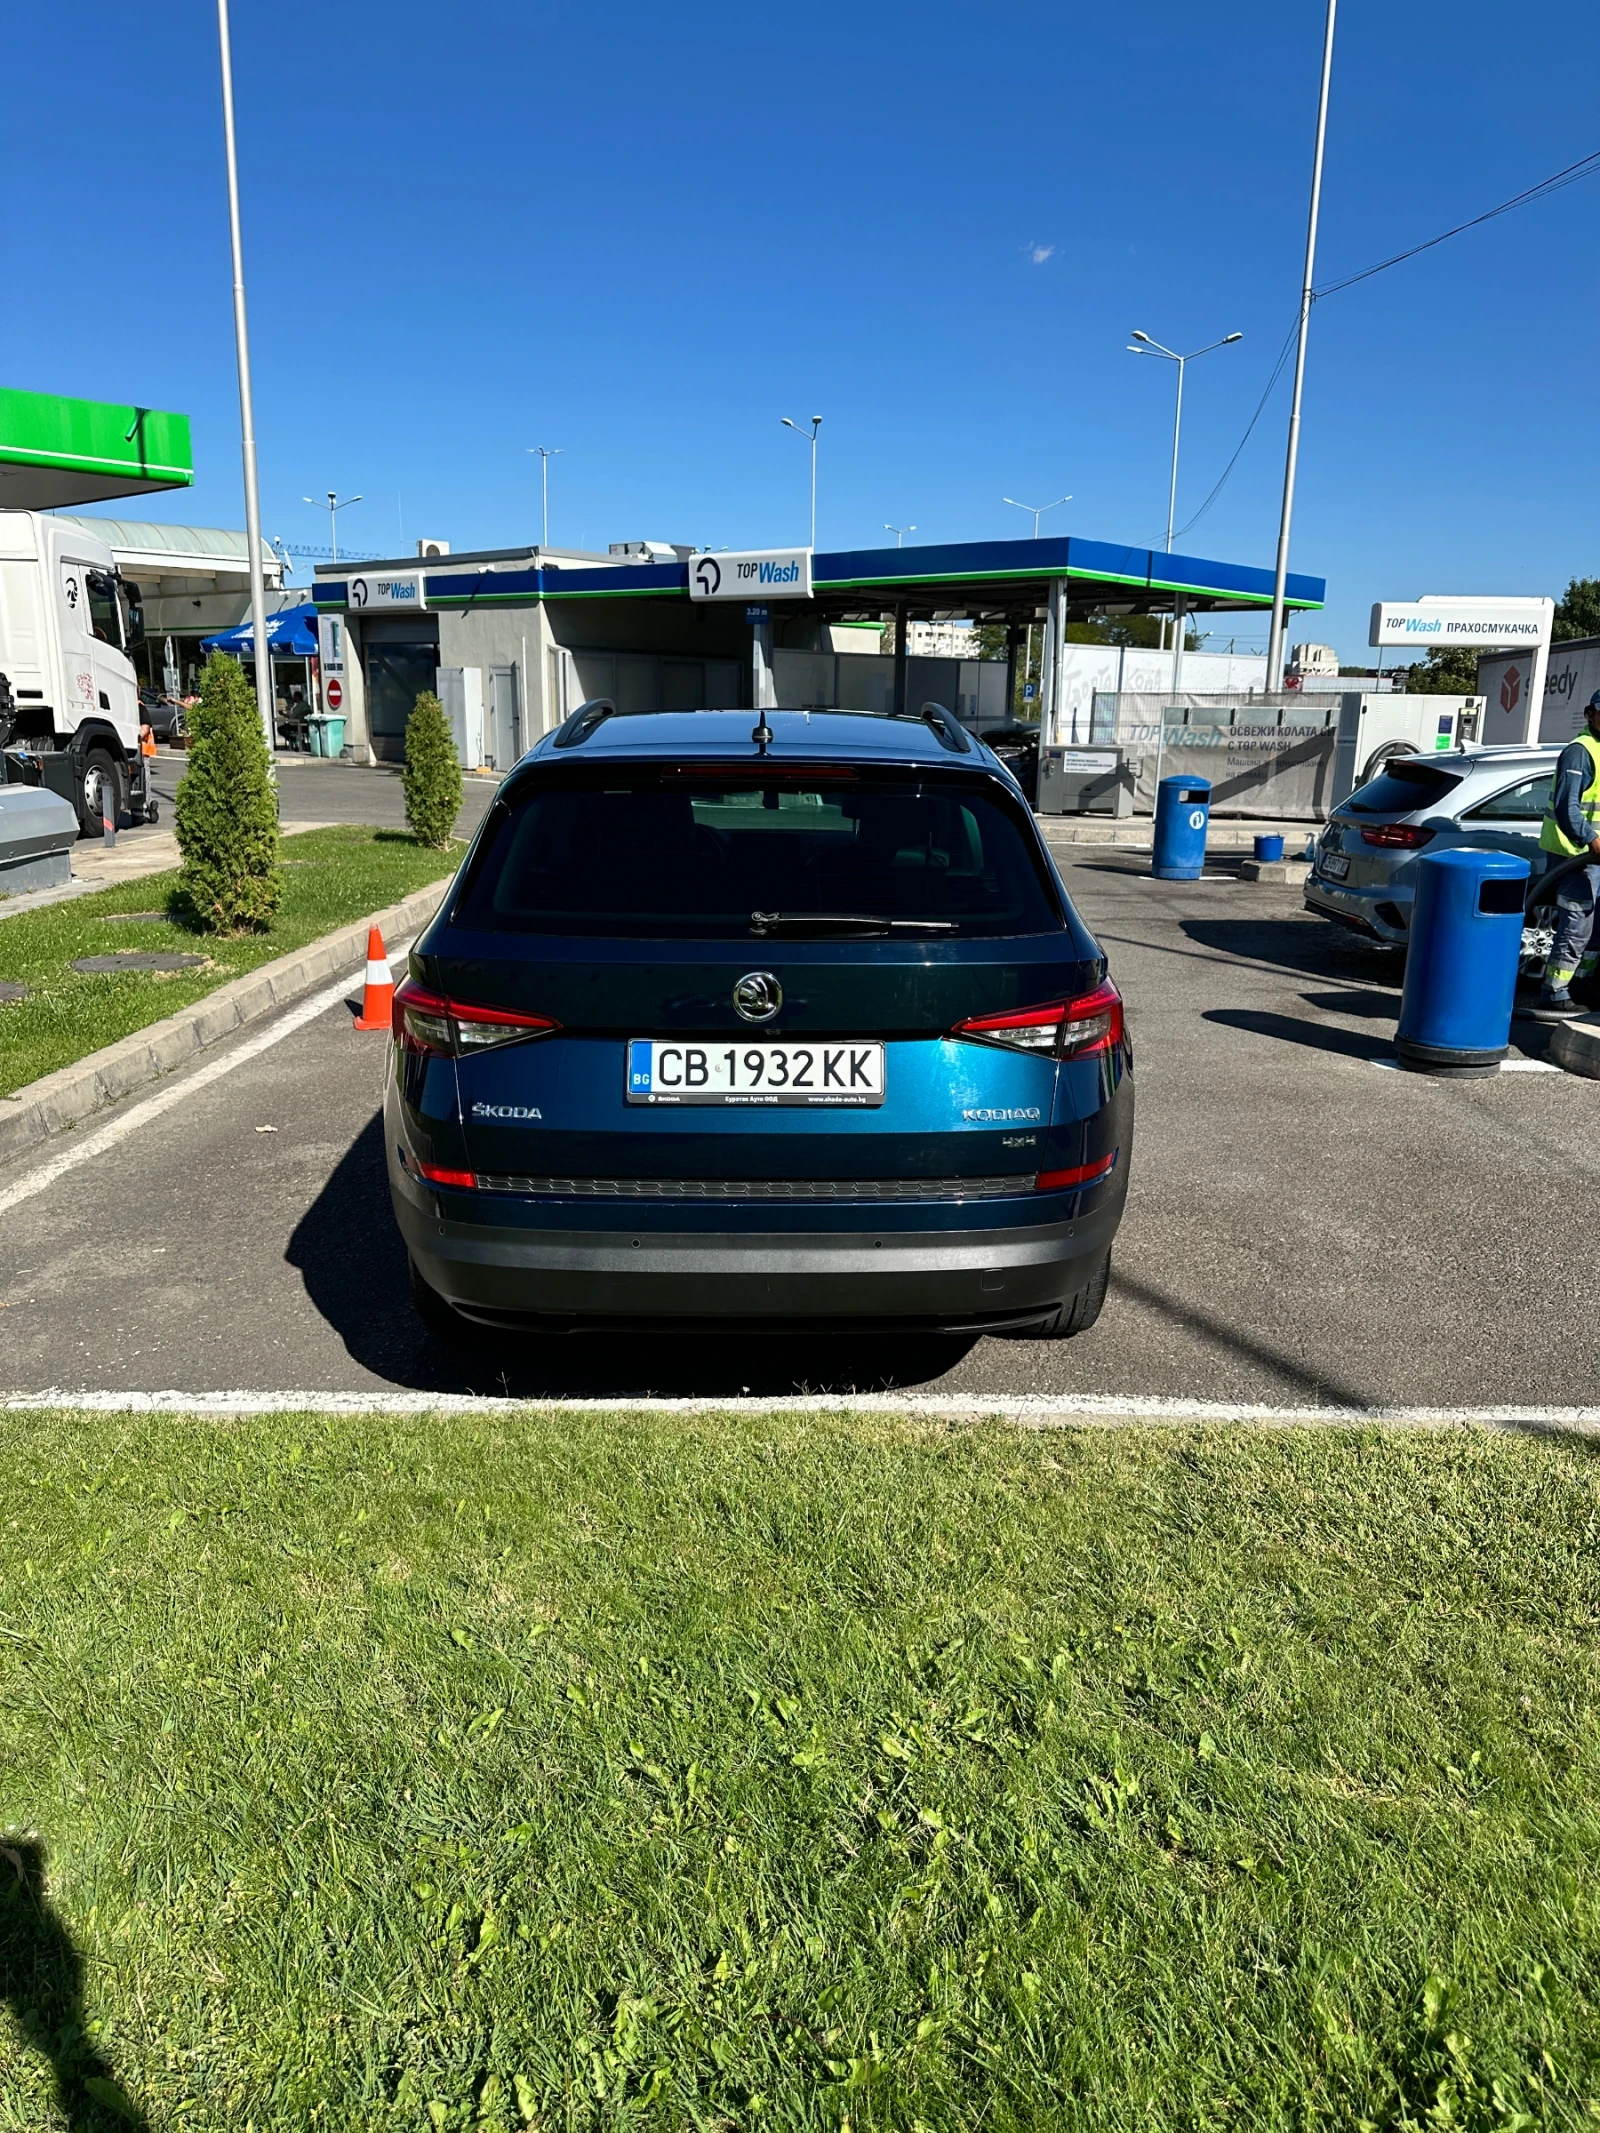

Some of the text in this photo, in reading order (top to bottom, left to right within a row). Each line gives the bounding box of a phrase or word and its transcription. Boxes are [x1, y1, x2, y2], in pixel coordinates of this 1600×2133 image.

[737, 560, 799, 583] TOP Wash
[378, 582, 415, 599] TOP Wash
[1386, 618, 1538, 634] TOP Wash ПРАХОСМУКАЧКА
[1524, 664, 1578, 701] seedy
[1025, 684, 1033, 698] P
[1130, 724, 1224, 749] TOP Wash
[1230, 726, 1275, 737] ОСВЕЖИ
[1277, 727, 1317, 737] КОЛАТА
[1237, 741, 1257, 751] TOP
[1259, 742, 1292, 752] WASH
[1227, 757, 1262, 767] Машина
[659, 1049, 874, 1087] CB 1932 KK
[633, 1073, 650, 1085] BG
[472, 1101, 543, 1120] ŠKODA
[963, 1107, 1041, 1121] KODIAQ
